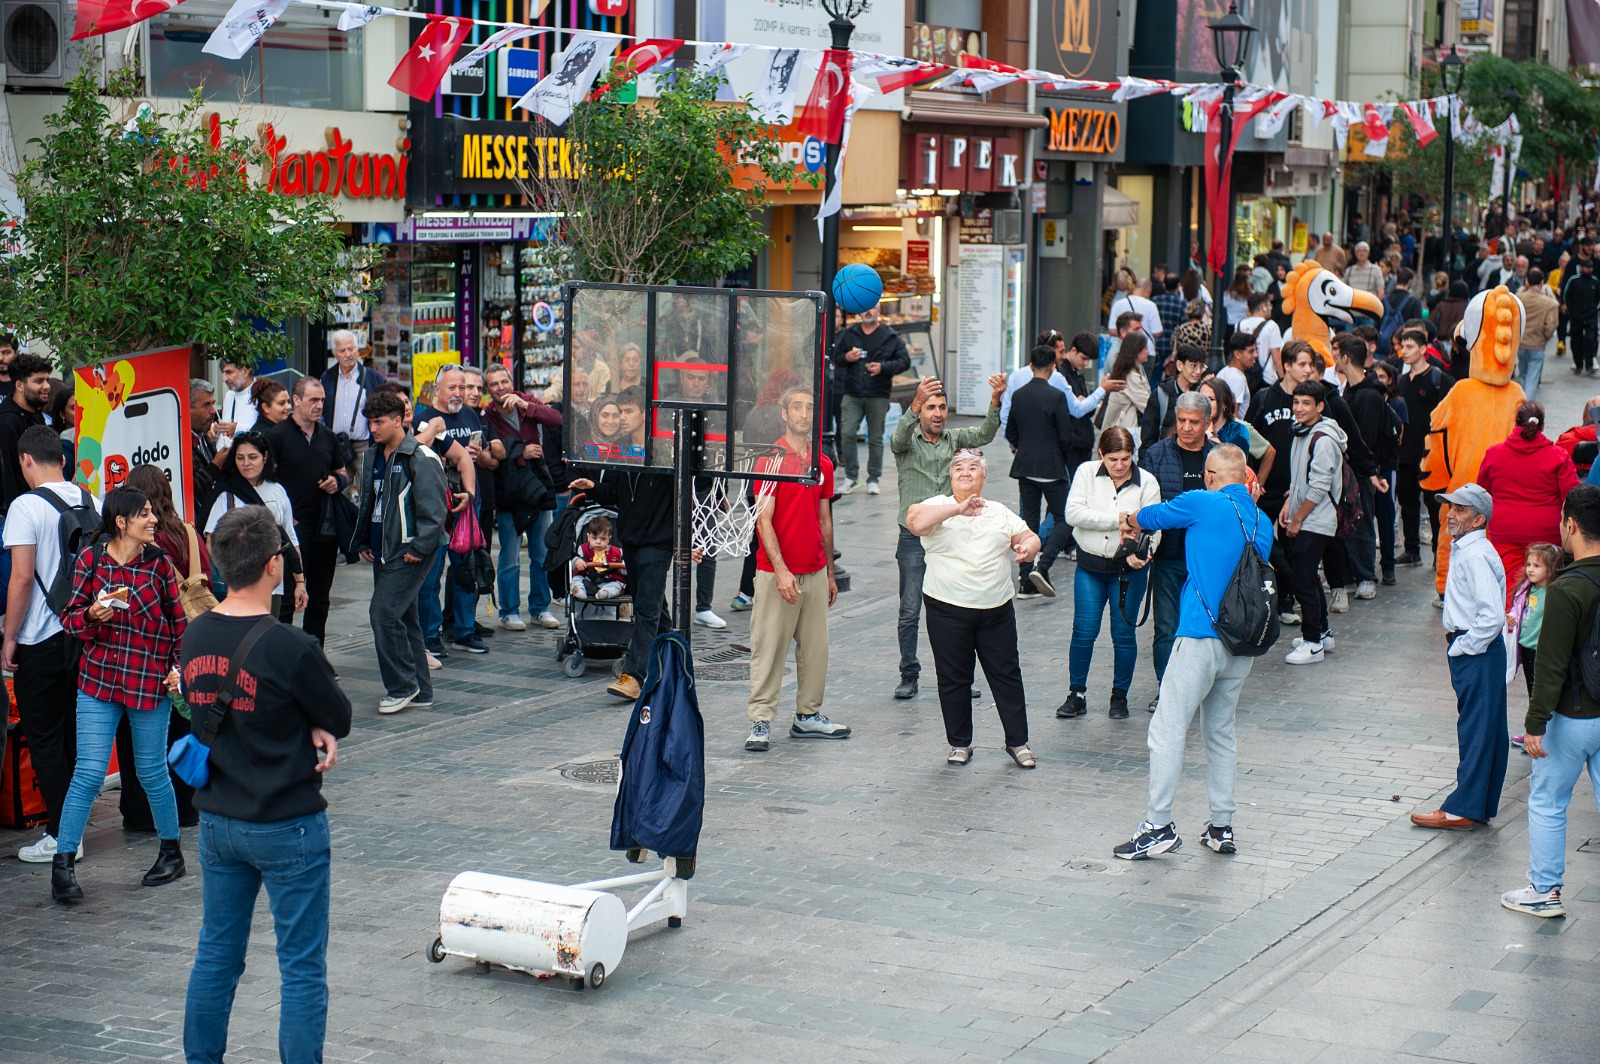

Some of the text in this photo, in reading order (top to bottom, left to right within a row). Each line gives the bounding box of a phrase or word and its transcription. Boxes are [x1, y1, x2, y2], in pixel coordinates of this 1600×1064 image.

[1059, 0, 1092, 54] M
[508, 67, 538, 79] SAMSUNG
[1048, 107, 1121, 154] MEZZO
[462, 134, 529, 180] MESSE
[416, 217, 453, 228] MESSE
[463, 249, 471, 260] 12
[461, 263, 472, 275] AY
[131, 441, 170, 467] dodo
